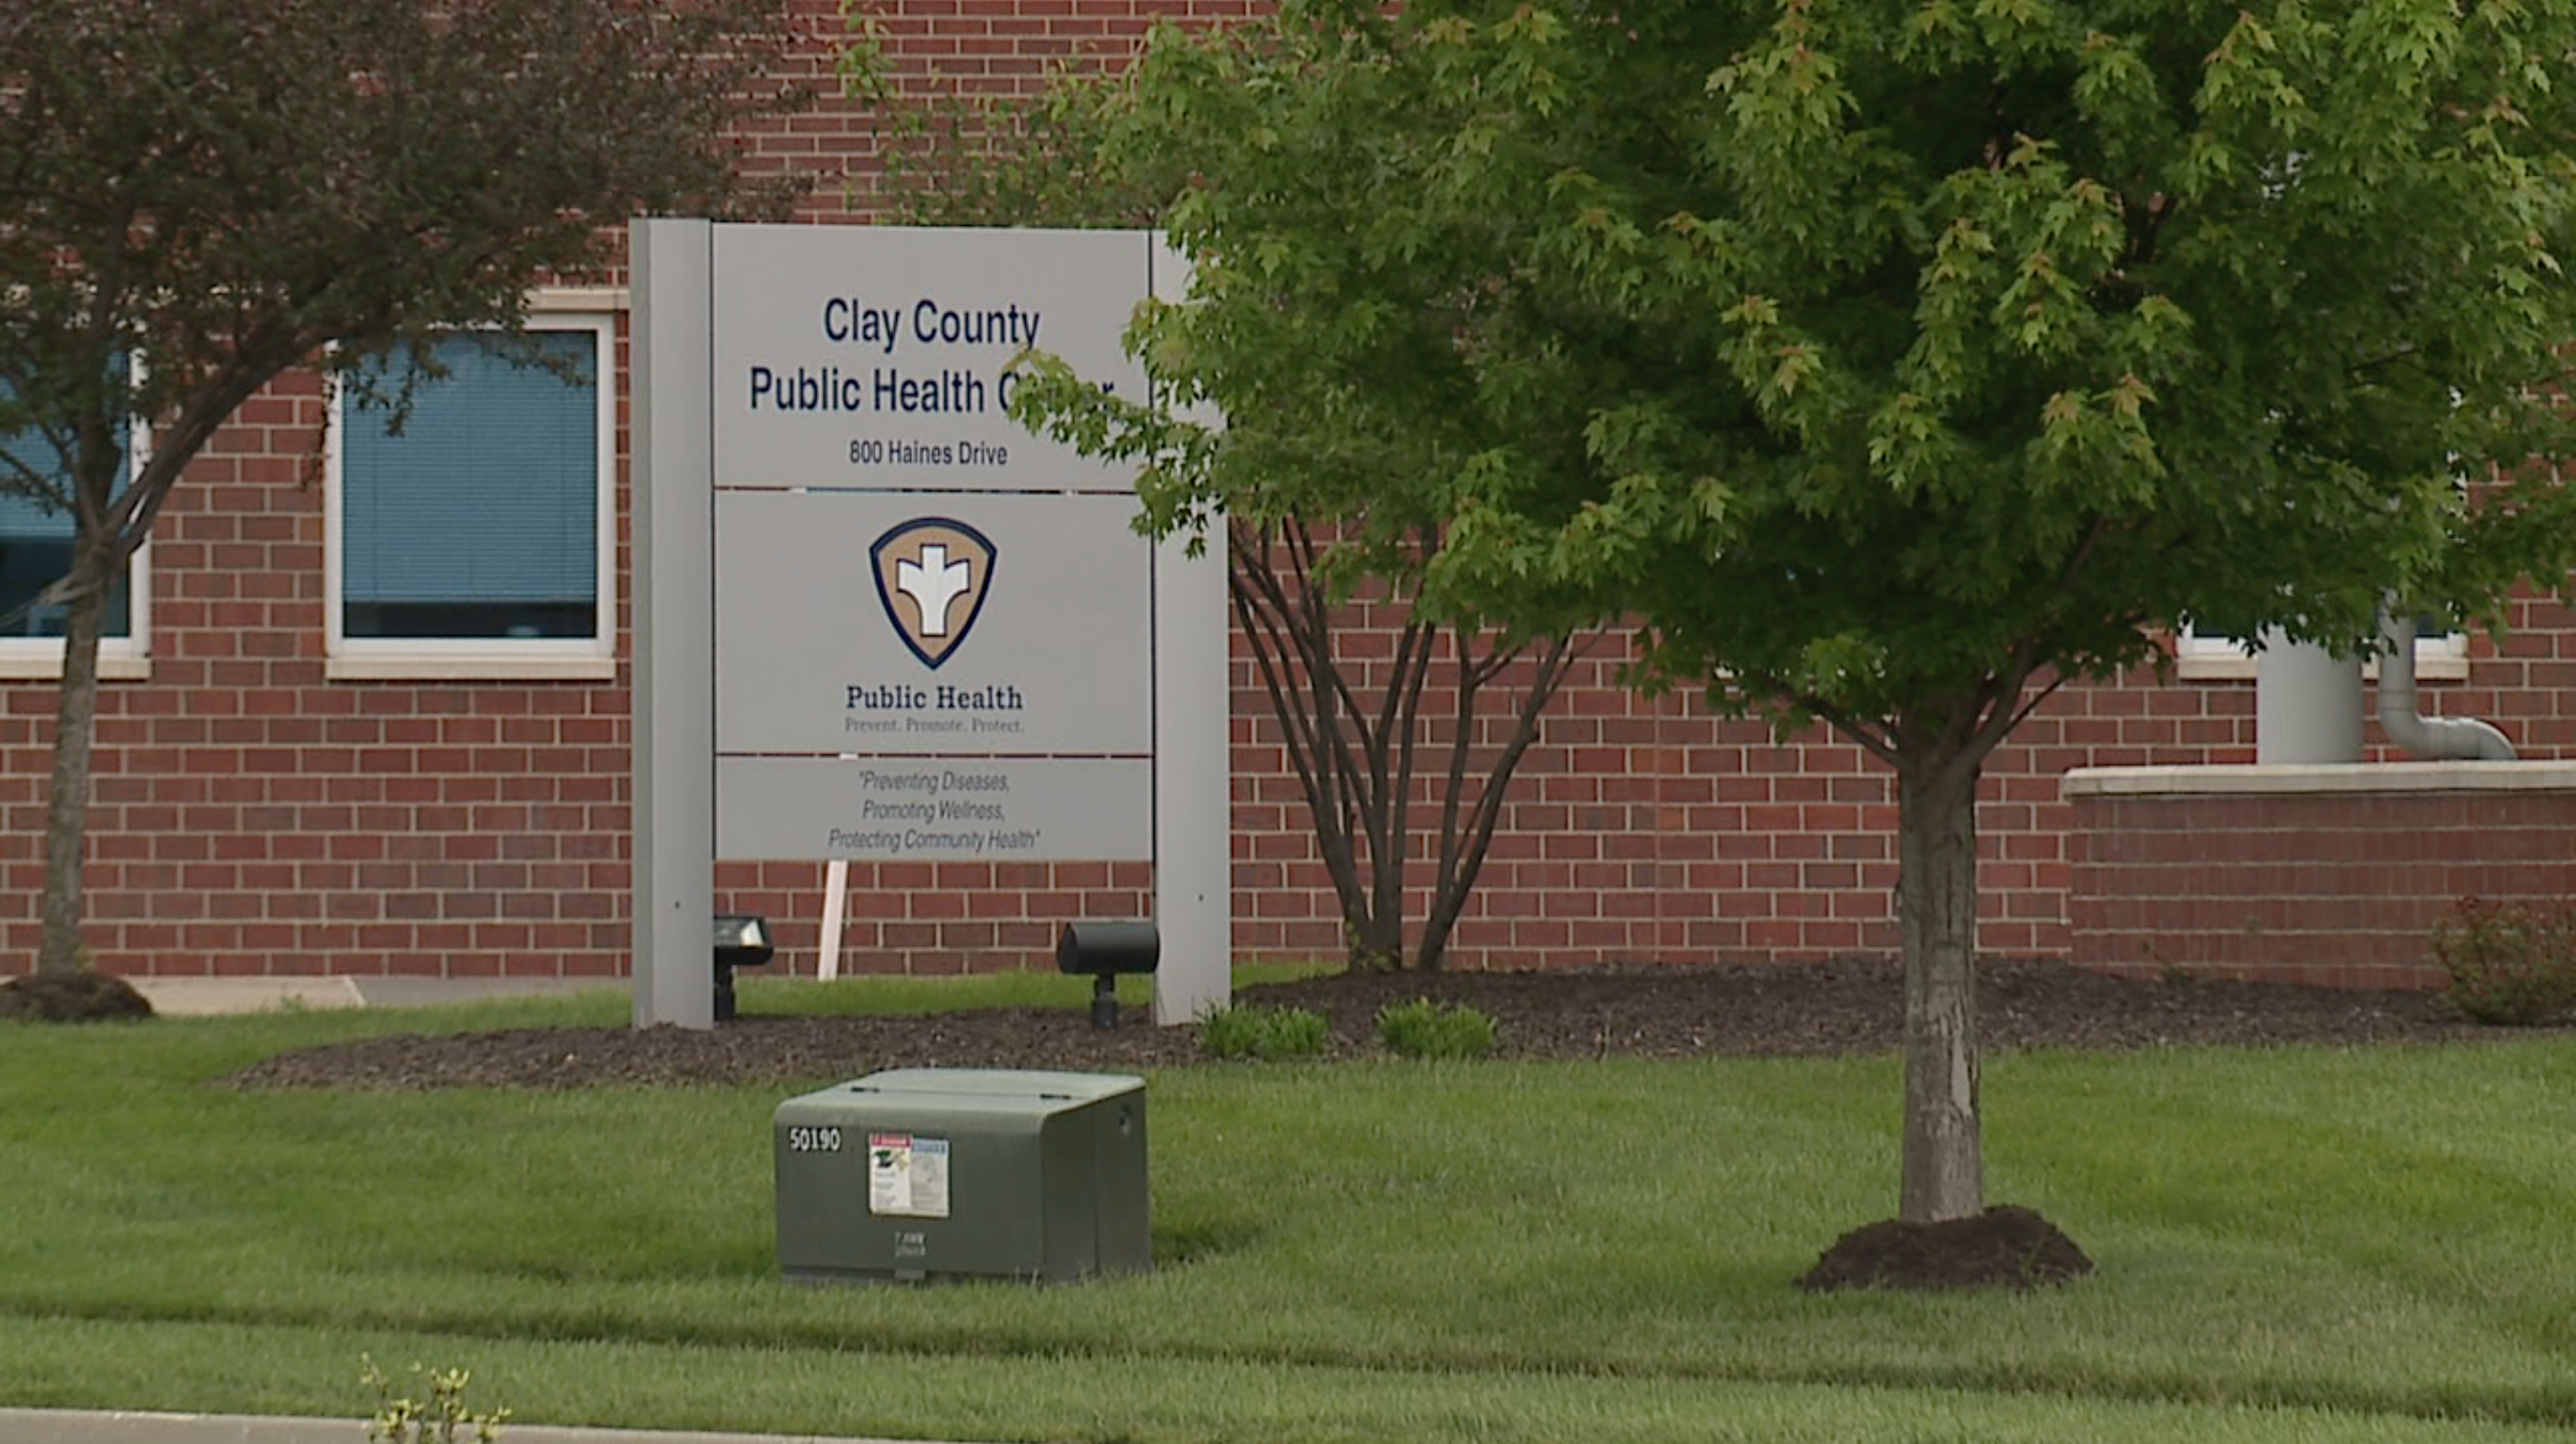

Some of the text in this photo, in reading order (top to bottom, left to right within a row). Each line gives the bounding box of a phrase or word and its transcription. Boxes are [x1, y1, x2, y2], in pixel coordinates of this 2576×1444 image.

[824, 298, 1040, 353] Clay County
[750, 366, 861, 411] Public
[873, 368, 984, 412] Health
[849, 440, 1008, 465] 800 Haines Drive
[846, 685, 1024, 710] Public Health
[941, 770, 1010, 793] Diseases,
[862, 799, 935, 824] Promoting
[828, 829, 904, 853] Protecting
[905, 829, 985, 853] Community
[790, 1127, 841, 1151] 50190
